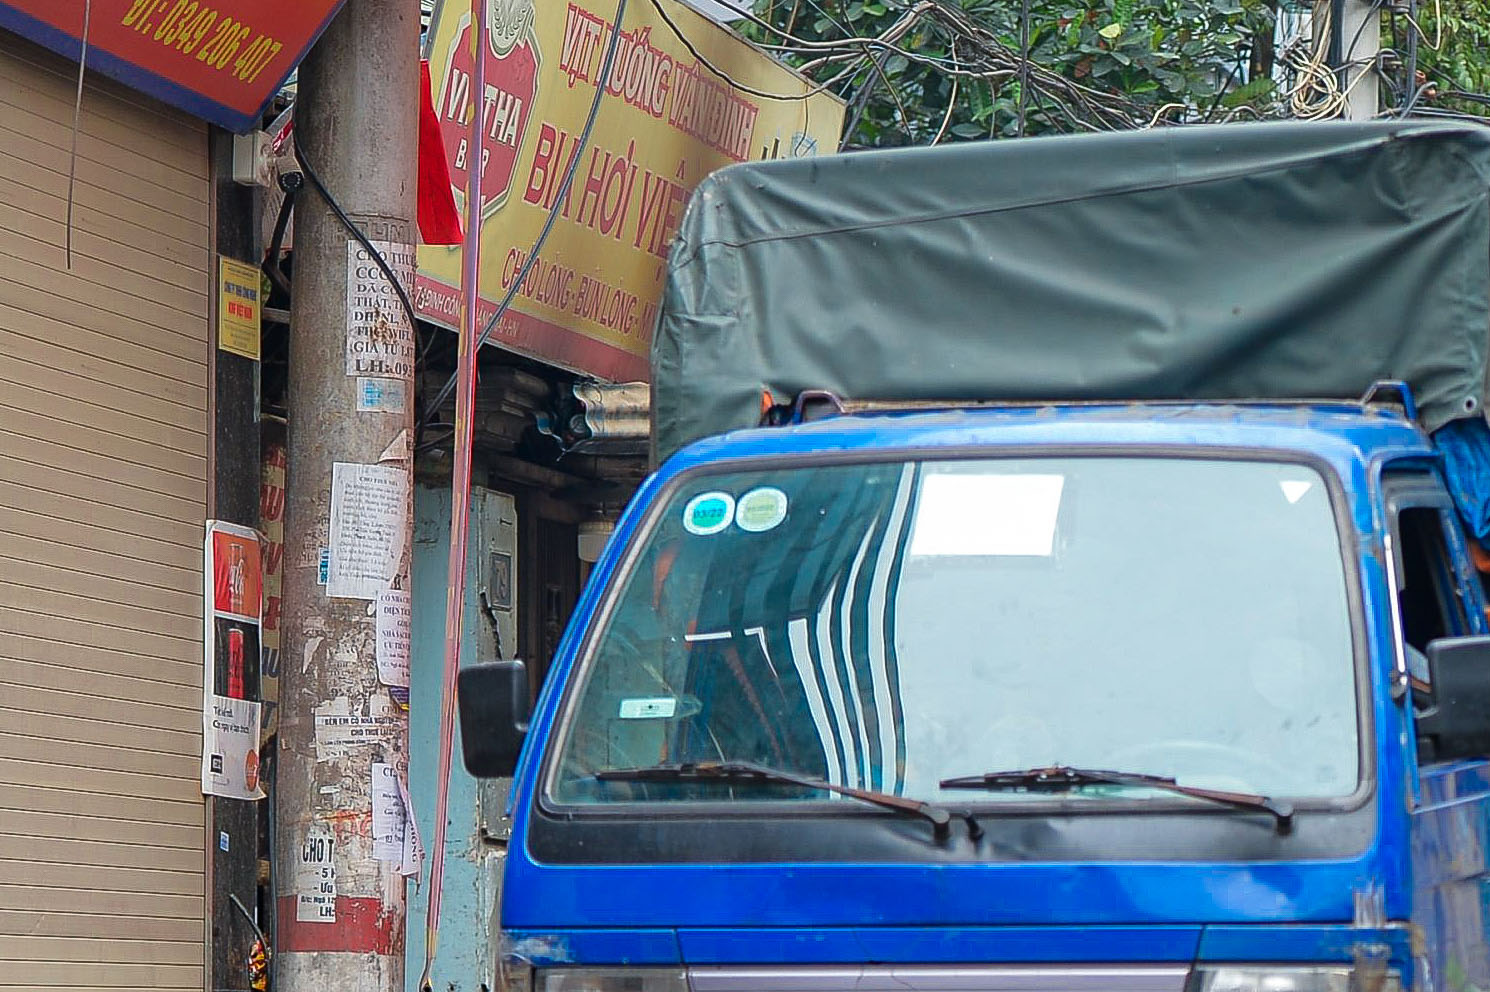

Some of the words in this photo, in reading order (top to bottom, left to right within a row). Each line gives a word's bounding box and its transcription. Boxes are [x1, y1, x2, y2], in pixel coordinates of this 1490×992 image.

[153, 0, 218, 54] 0349
[195, 17, 251, 70] 206
[232, 34, 283, 84] 407
